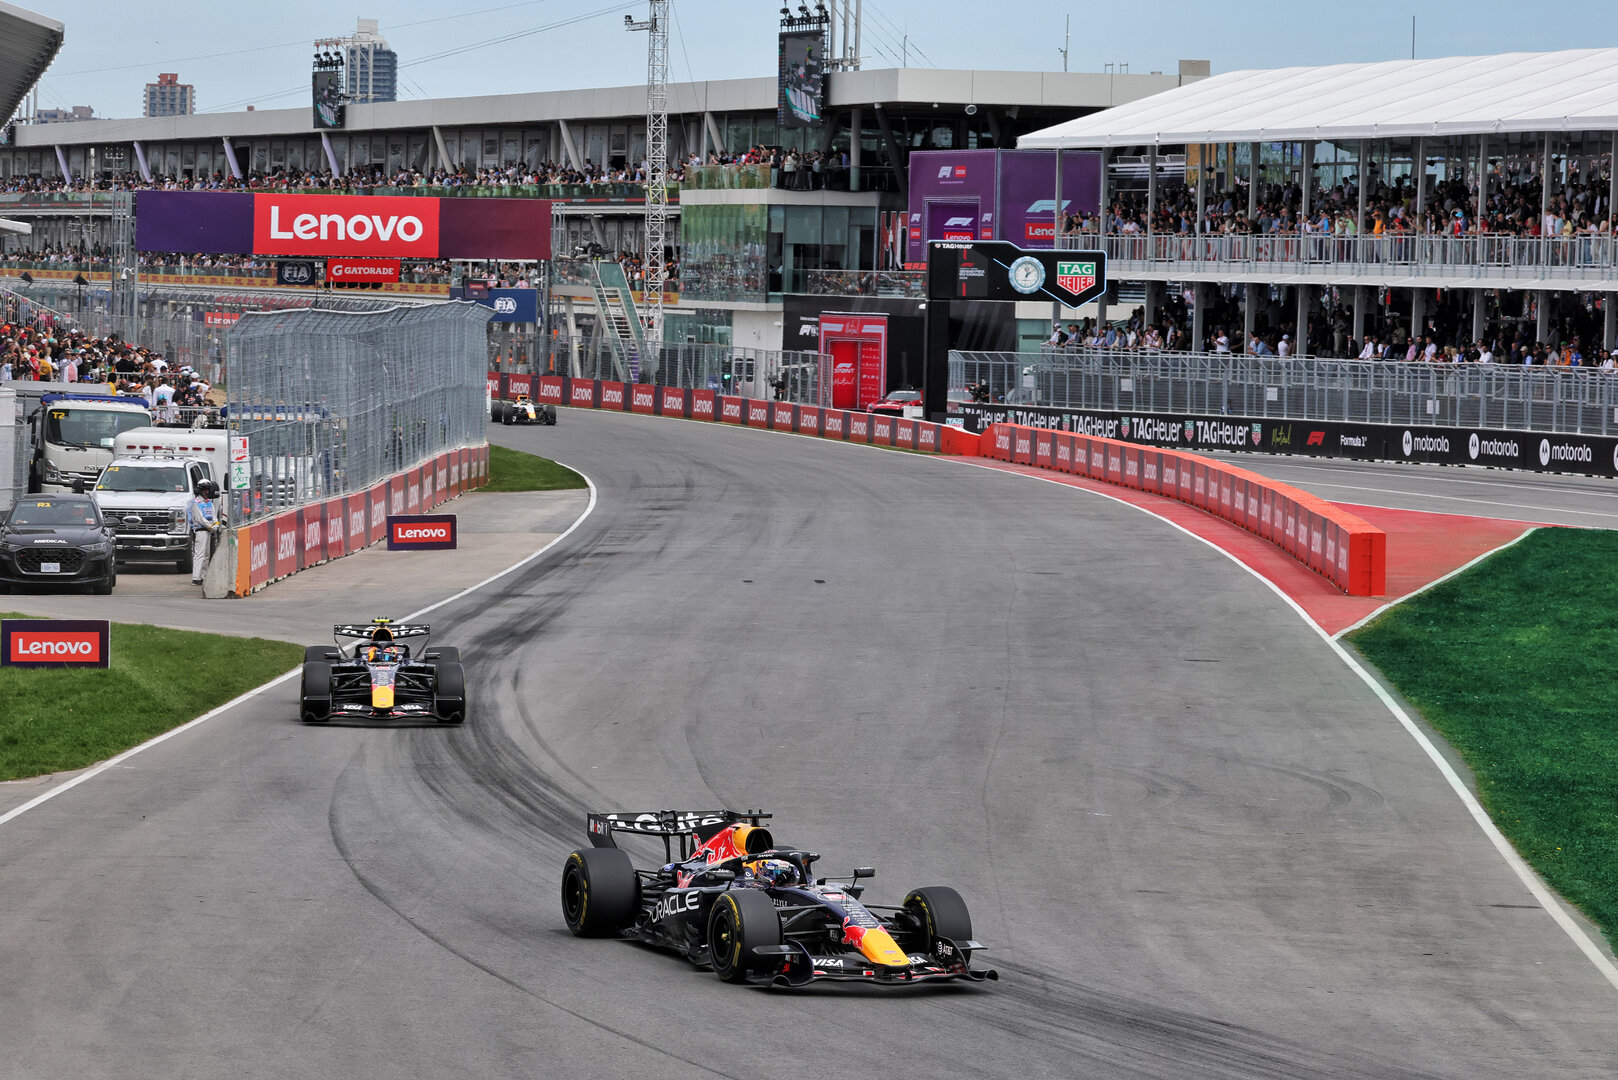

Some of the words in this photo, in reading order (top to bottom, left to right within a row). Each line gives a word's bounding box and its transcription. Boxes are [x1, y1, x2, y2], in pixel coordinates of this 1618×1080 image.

[270, 205, 424, 242] Lenovo
[1029, 225, 1055, 236] Leno
[284, 265, 308, 278] FIA
[344, 266, 394, 275] GATORADE
[1060, 264, 1092, 274] TAG
[1060, 277, 1093, 292] HEUER
[496, 300, 514, 310] FIA
[540, 381, 561, 397] Lenovo
[572, 384, 592, 400] Lenovo
[602, 386, 622, 403] Lenovo
[633, 389, 653, 407] Lenovo
[664, 392, 682, 410] Lenovo
[693, 396, 713, 413] Lenovo
[723, 400, 740, 418] Lenovo
[52, 411, 65, 420] T2
[749, 404, 767, 421] Lenovo
[775, 407, 791, 424] Lenovo
[801, 410, 817, 428] Lenovo
[826, 414, 842, 431] Lenovo
[851, 417, 866, 435] Lenovo
[874, 420, 890, 438] Lenovo
[1072, 415, 1118, 438] TAGHeuer
[1132, 418, 1182, 442] TAGHeuer
[898, 423, 912, 441] Lenovo
[920, 426, 934, 444] Lenovo
[1196, 421, 1249, 445] TAGHeuer
[1340, 434, 1361, 447] Formula
[1413, 434, 1449, 453] motorola
[1480, 438, 1518, 457] motorola
[1552, 443, 1592, 462] motorola
[305, 518, 320, 551] Lenovo
[328, 513, 343, 544] Lenovo
[398, 526, 446, 539] Lenovo
[277, 527, 295, 560] Lenovo
[251, 540, 267, 572] Lenovo
[18, 638, 92, 655] Lenovo
[650, 890, 700, 923] ORACLE
[812, 958, 844, 967] VISA
